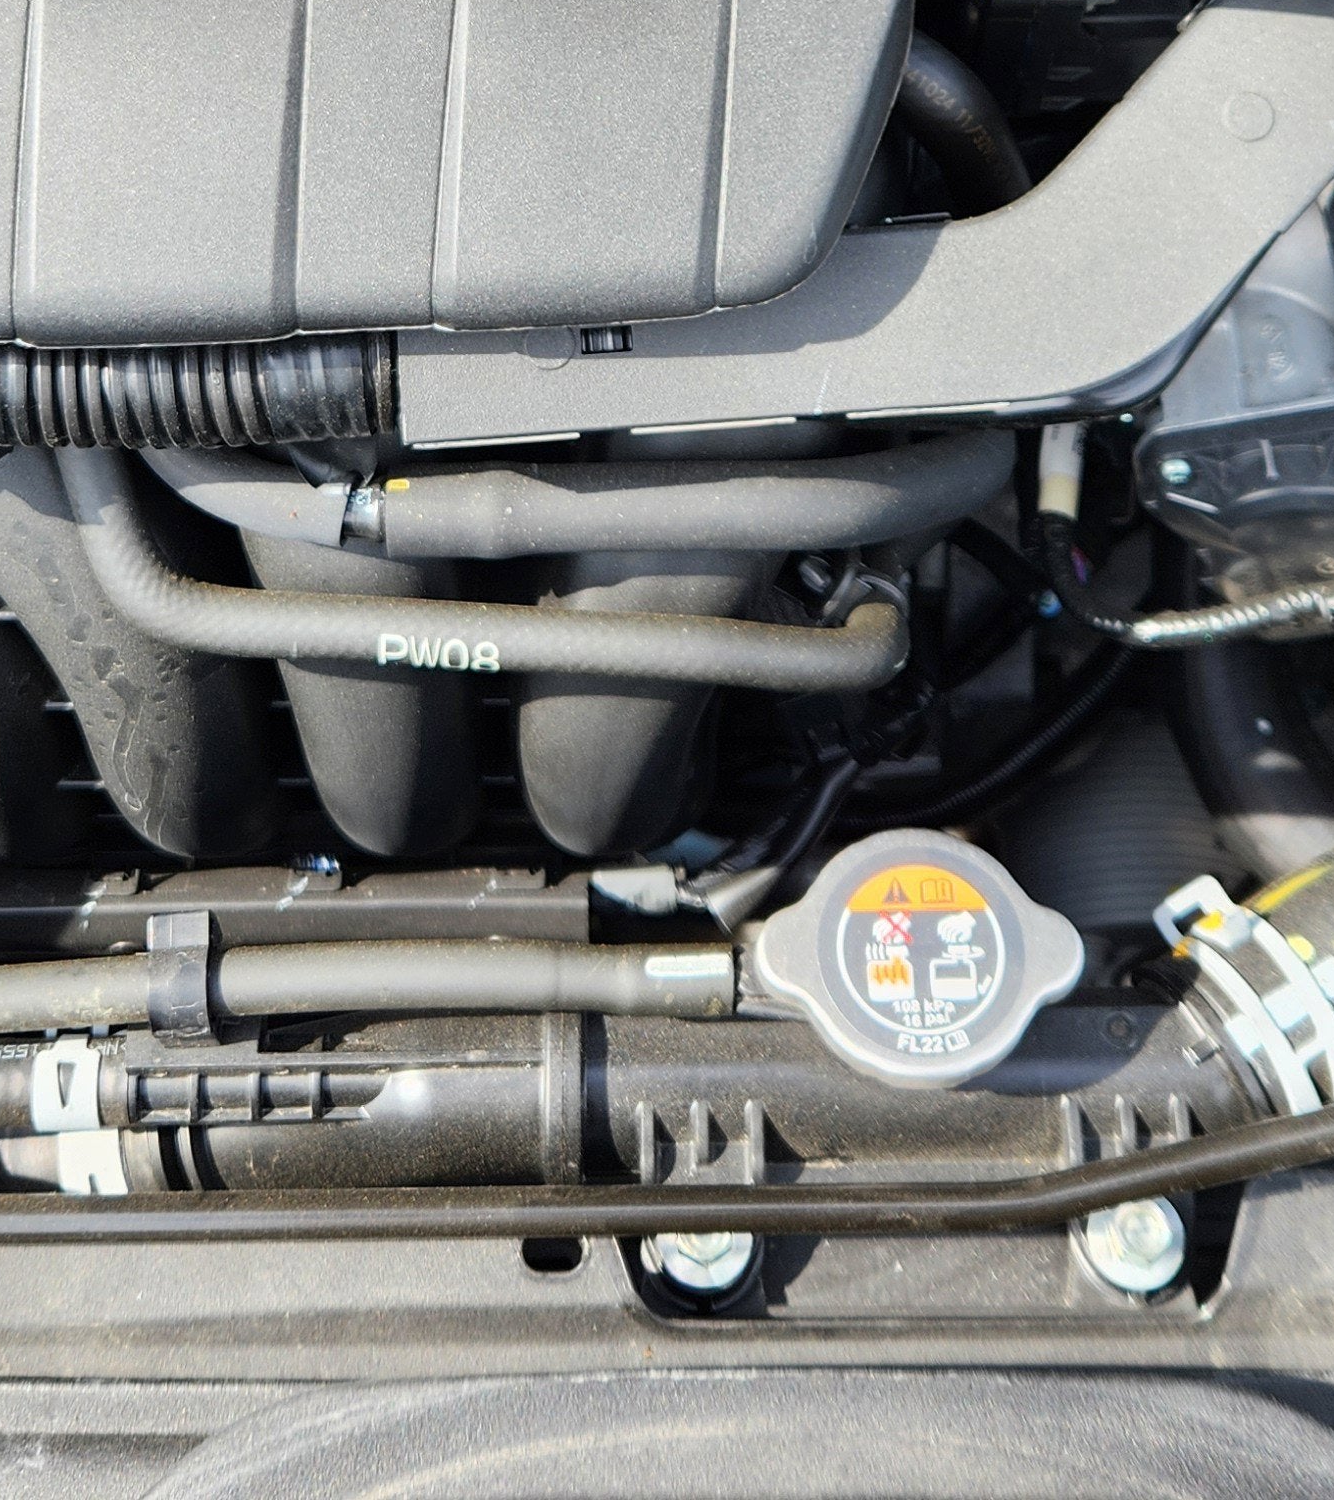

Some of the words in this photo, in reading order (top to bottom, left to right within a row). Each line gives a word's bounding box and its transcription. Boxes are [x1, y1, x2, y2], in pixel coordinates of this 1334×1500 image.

[376, 633, 501, 673] PW08
[892, 999, 921, 1013] 108
[923, 998, 956, 1013] kPa
[902, 1014, 922, 1028] 16
[924, 1011, 951, 1028] psi
[897, 1032, 945, 1053] FL22
